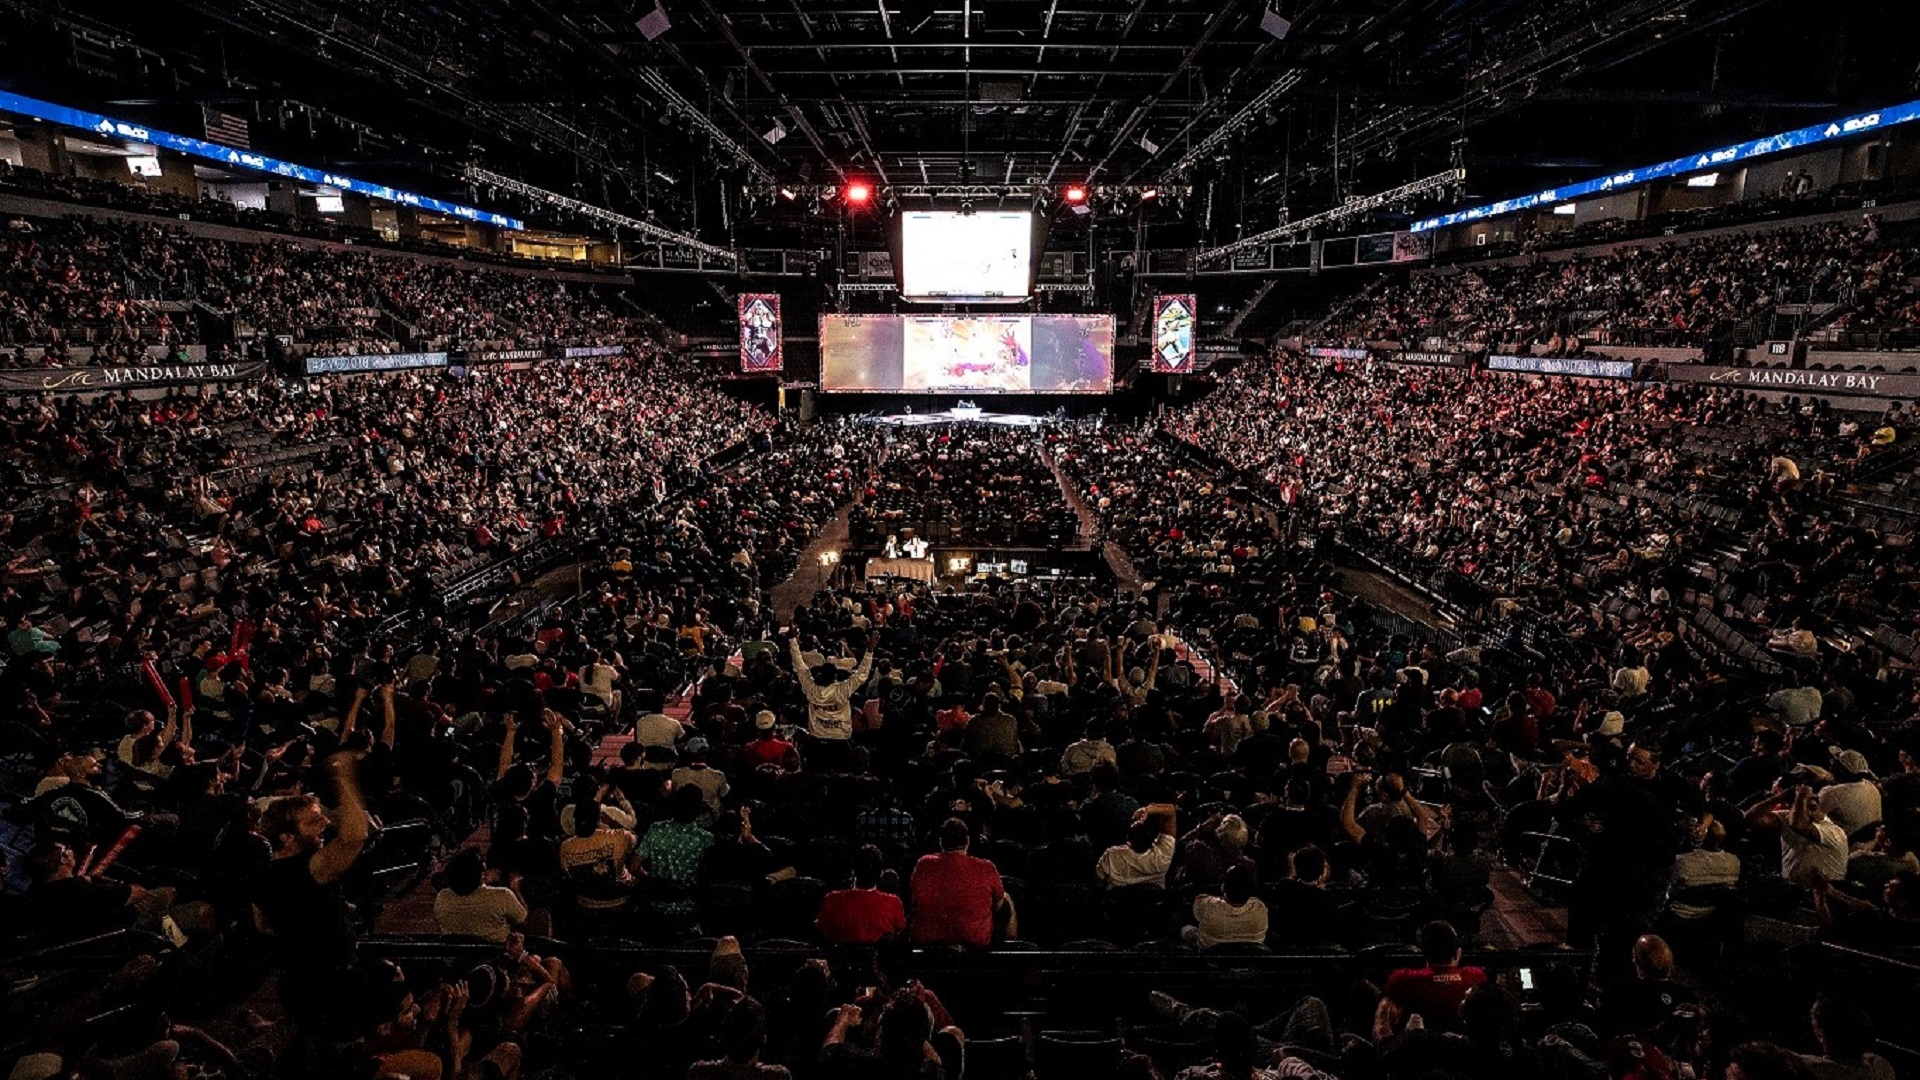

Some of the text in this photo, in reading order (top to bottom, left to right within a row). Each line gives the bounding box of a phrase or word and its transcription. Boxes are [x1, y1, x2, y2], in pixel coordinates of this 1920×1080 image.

[103, 363, 237, 383] MANDALAY BAY
[1748, 370, 1881, 390] MANDALAY BAY
